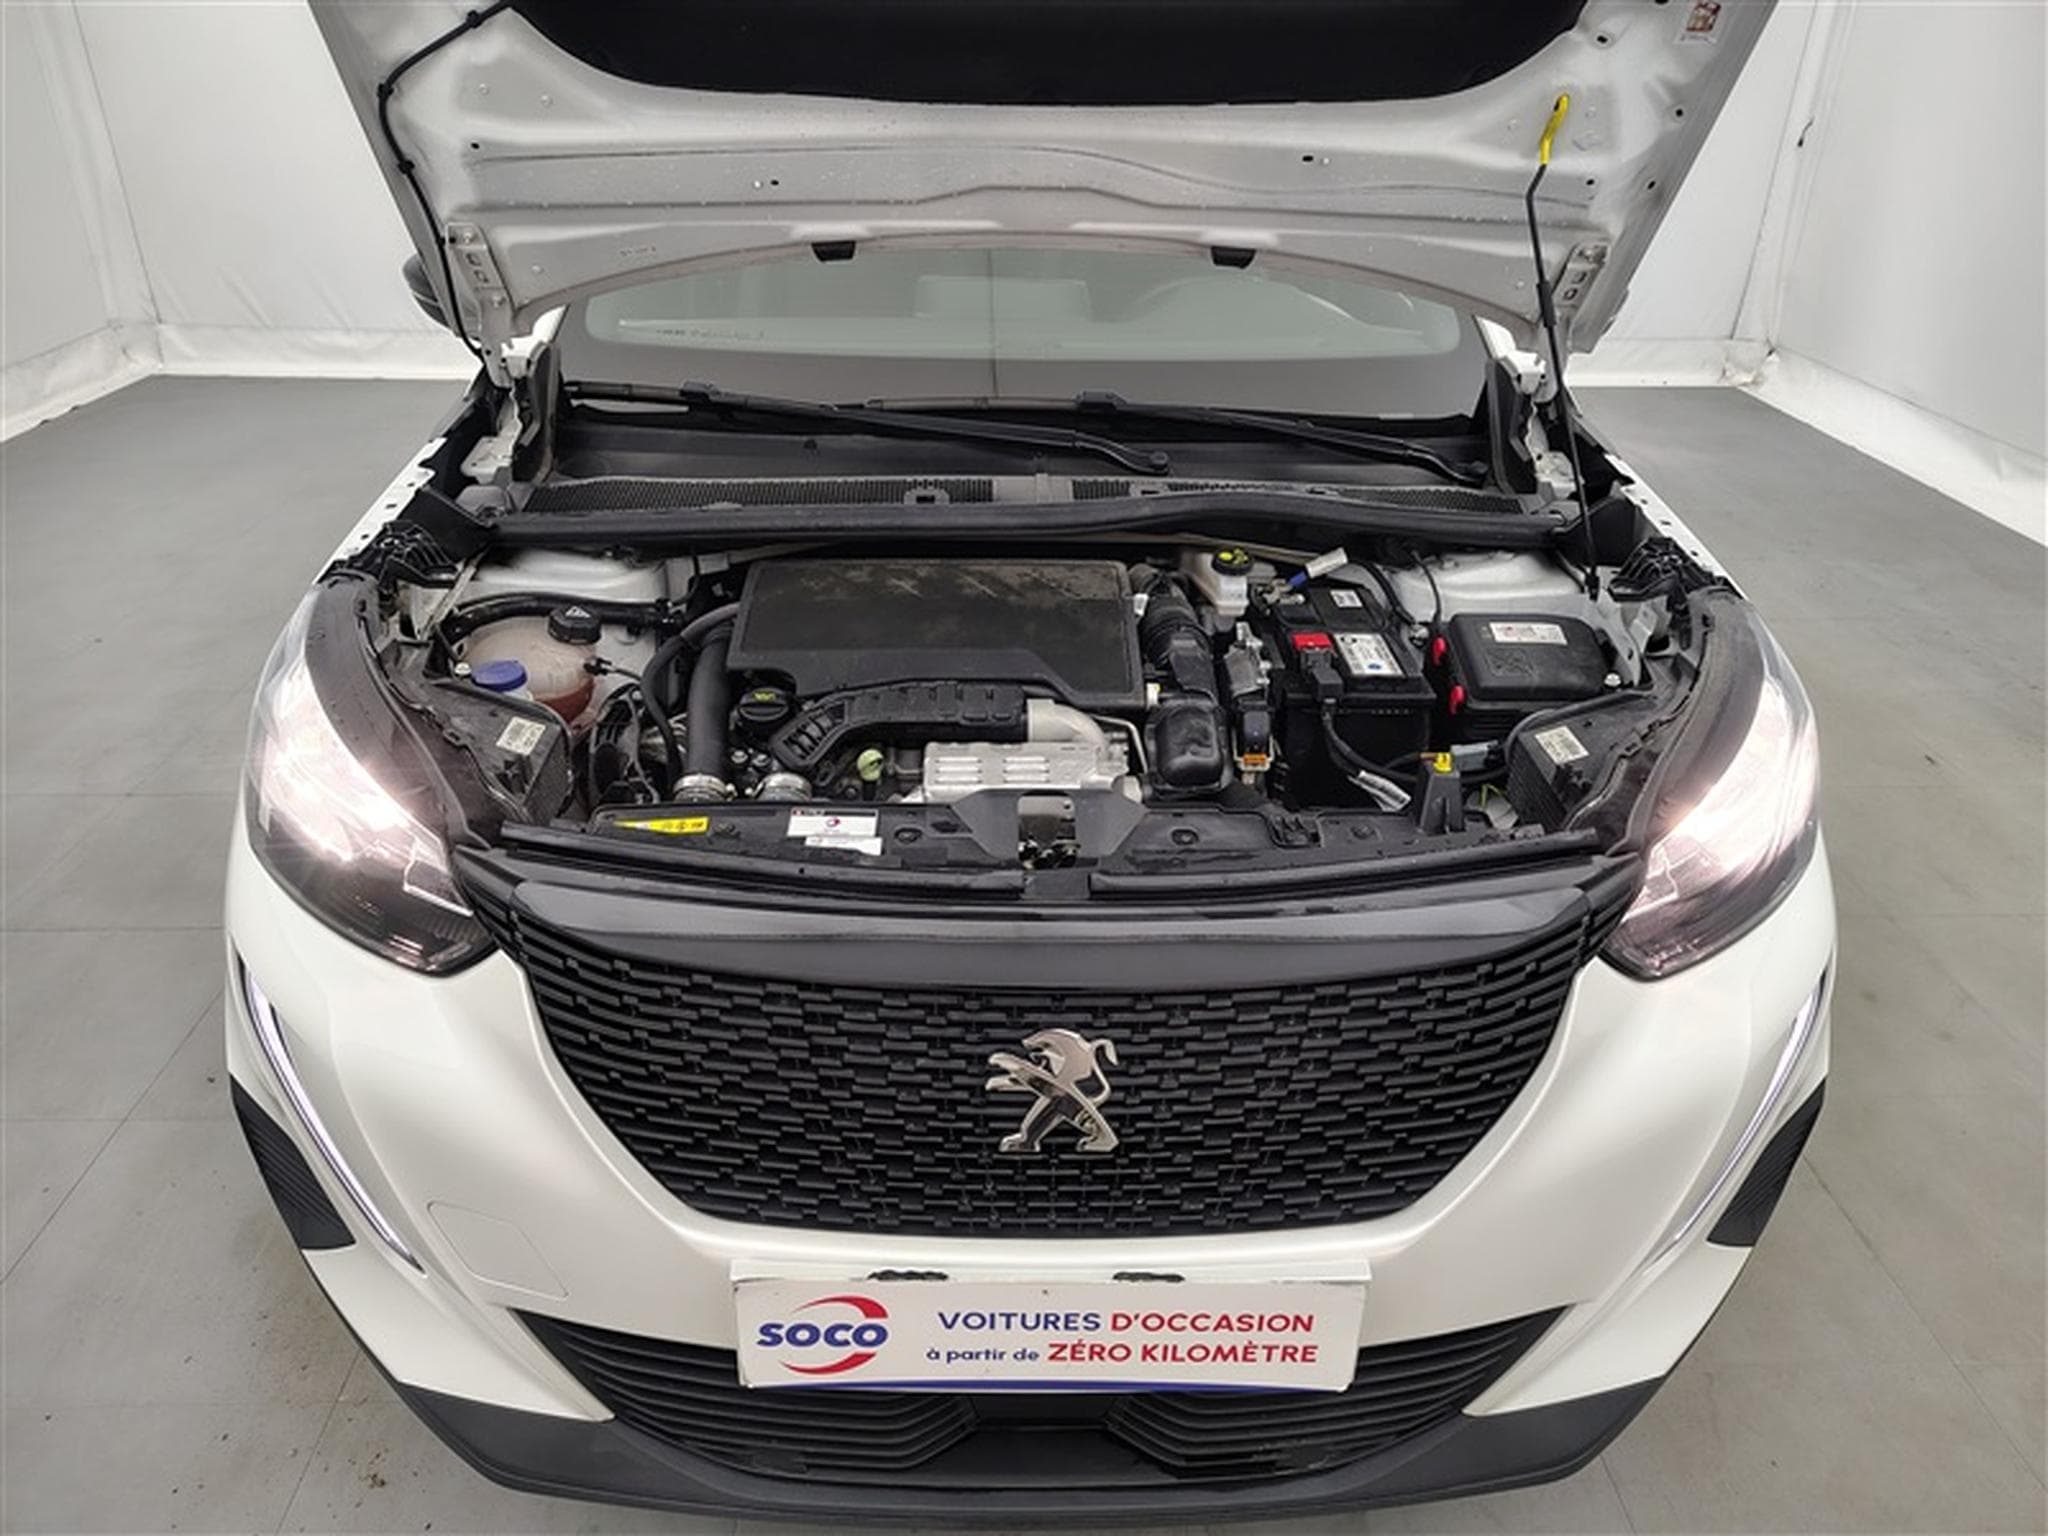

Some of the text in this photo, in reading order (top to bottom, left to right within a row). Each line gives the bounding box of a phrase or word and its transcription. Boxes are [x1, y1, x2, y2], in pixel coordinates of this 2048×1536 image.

[938, 1312, 1314, 1332] VOITURES D'OCCASION
[756, 1322, 889, 1348] SOCO
[926, 1339, 1319, 1364] à partir de ZÉRO KILOMÈTRE
